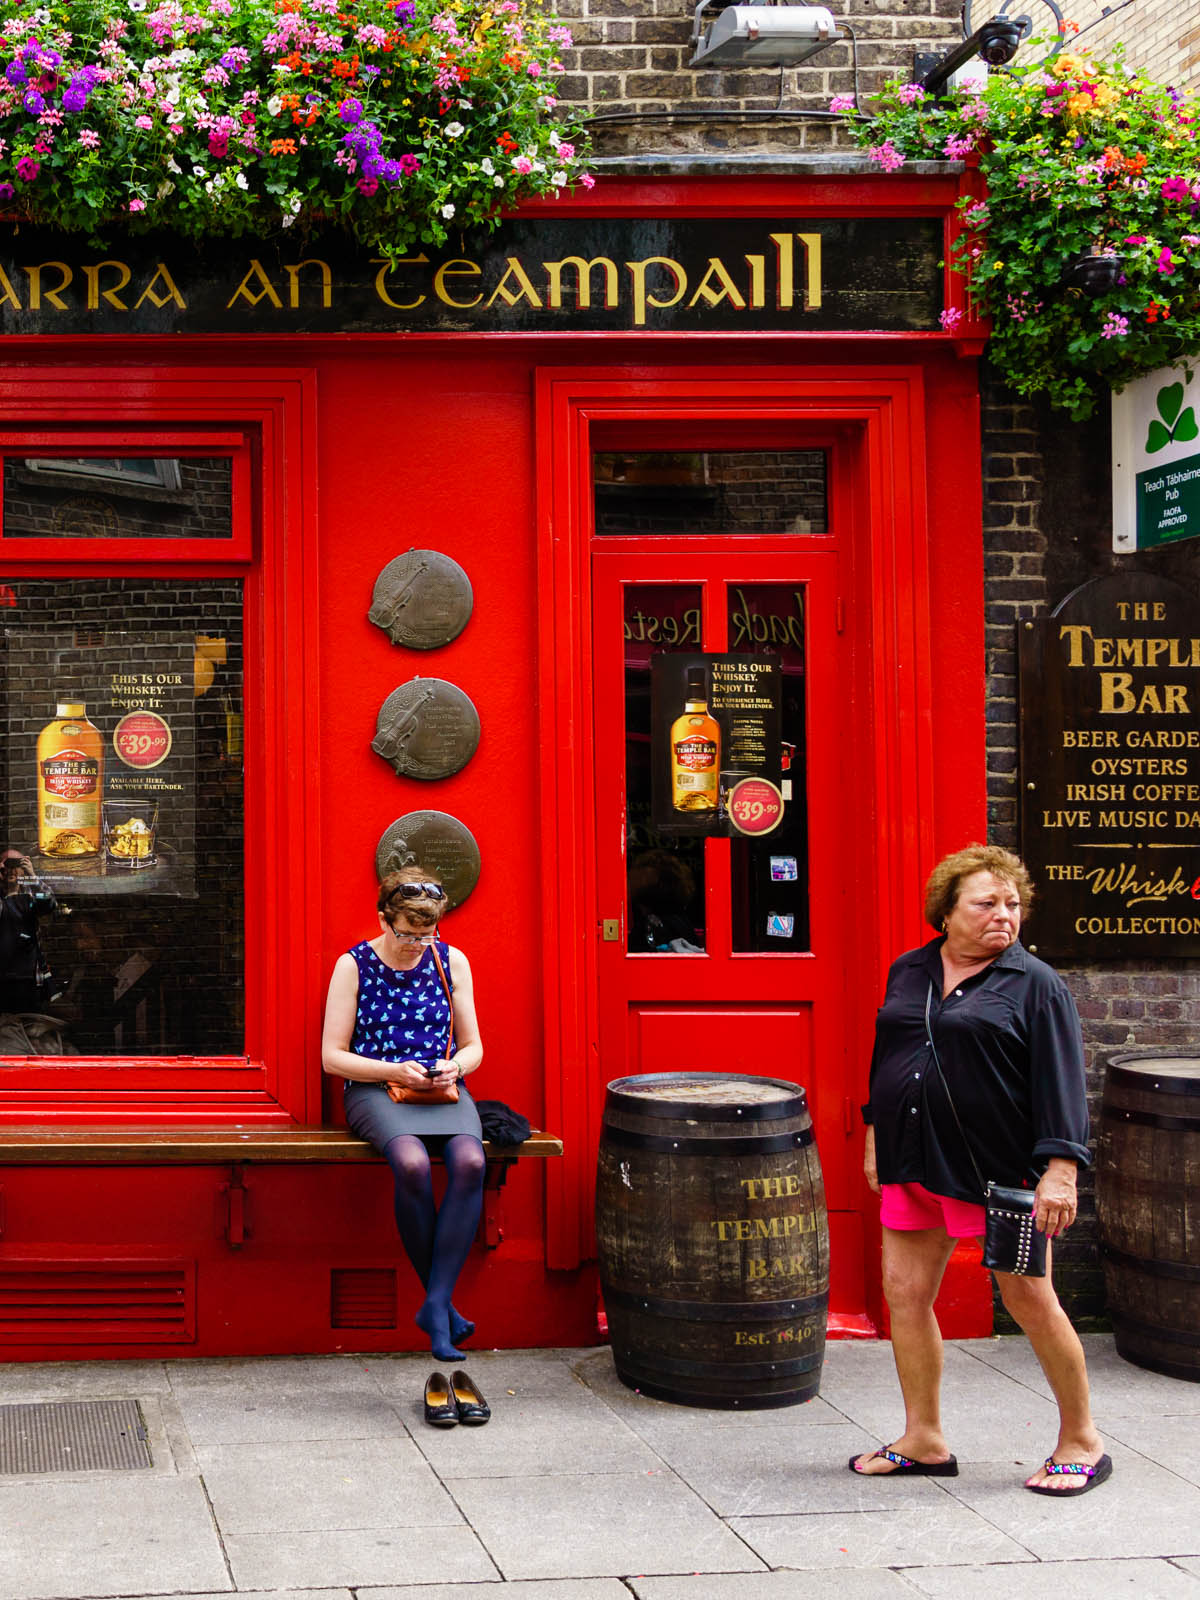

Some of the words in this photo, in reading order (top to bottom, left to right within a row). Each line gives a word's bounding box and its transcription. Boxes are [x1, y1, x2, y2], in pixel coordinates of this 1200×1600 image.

[1144, 478, 1165, 494] Teach
[1165, 489, 1179, 502] Pub
[1158, 514, 1188, 529] APPROVED
[1117, 602, 1166, 621] THE
[712, 663, 735, 671] THIS
[738, 663, 747, 671] IS
[750, 663, 772, 672] OUR
[112, 675, 138, 684] THIS
[142, 675, 153, 684] IS
[156, 674, 182, 684] OUR
[712, 672, 758, 681] WHISKEY.
[111, 686, 166, 695] WHISKEY.
[712, 684, 742, 693] ENJOY
[744, 683, 756, 692] IT.
[1098, 672, 1191, 714] BAR
[111, 698, 145, 708] ENJOY
[149, 698, 163, 708] IT.
[1062, 731, 1120, 748] BEER
[1126, 731, 1200, 748] GARDE
[1091, 758, 1188, 776] OYSTERS
[1066, 784, 1126, 801] IRISH
[1132, 784, 1200, 801] COFFE
[1042, 811, 1092, 828] LIVE
[1098, 811, 1168, 828] MUSIC
[1045, 865, 1084, 880] THE
[741, 1175, 800, 1200] THE
[747, 1255, 806, 1280] BAR
[735, 1331, 770, 1345] Est.
